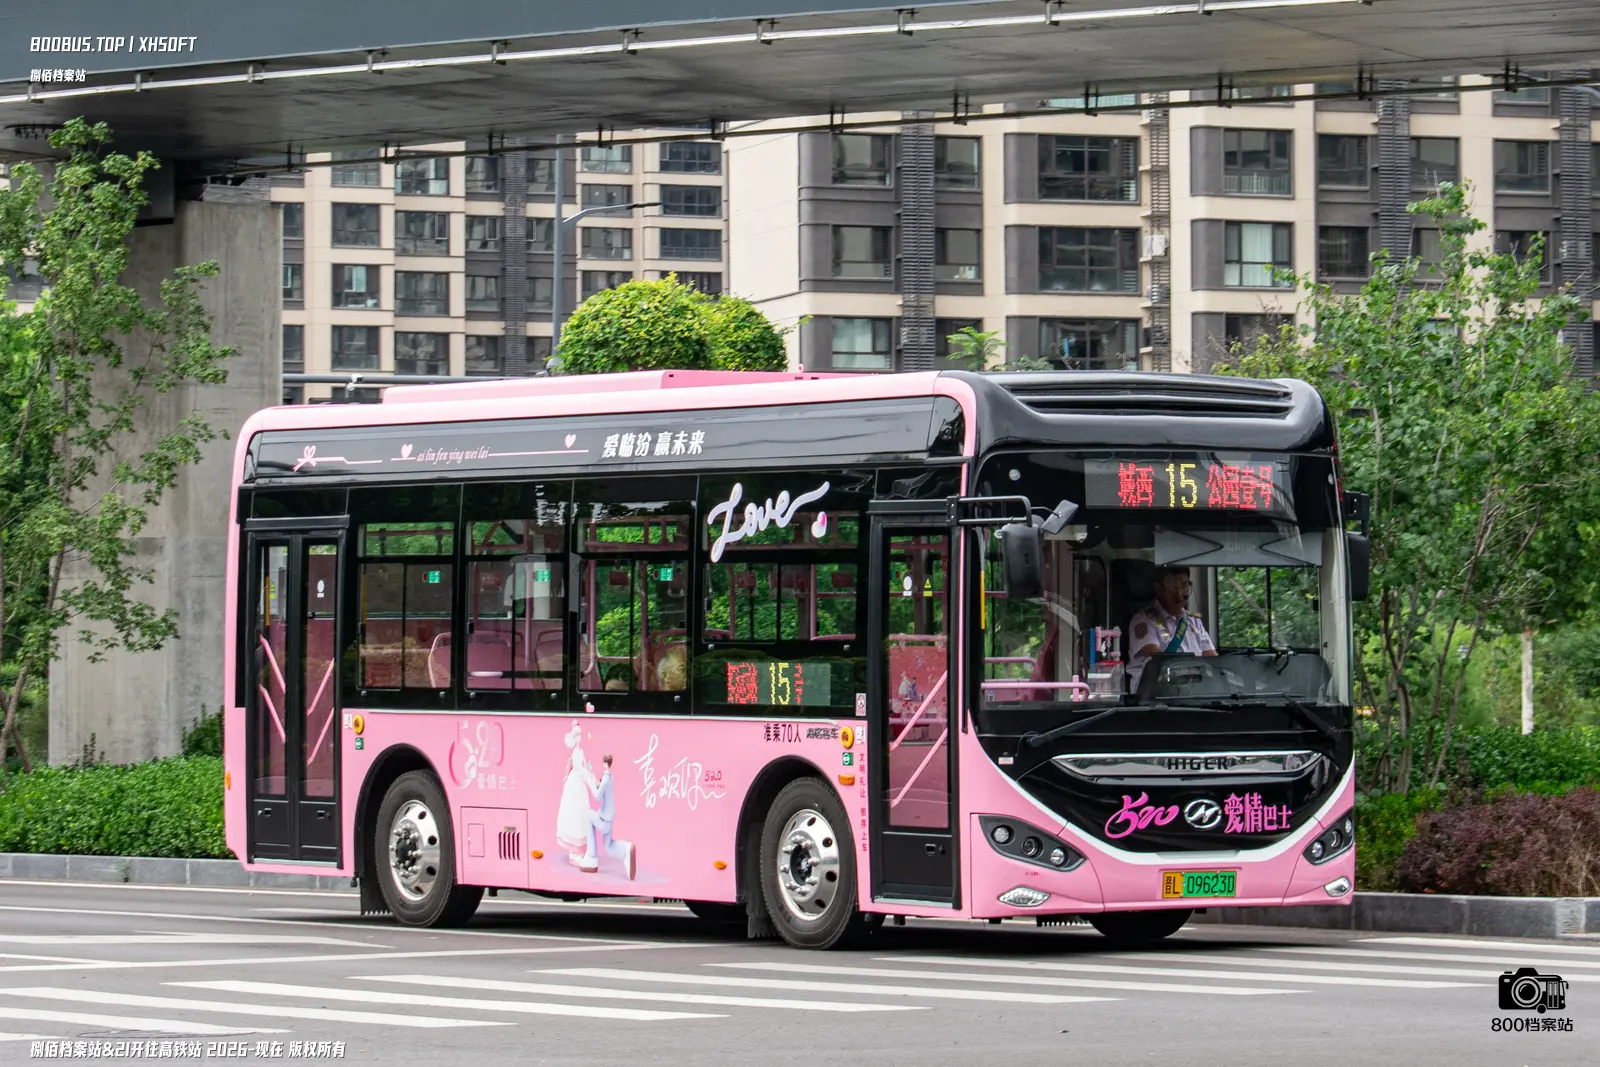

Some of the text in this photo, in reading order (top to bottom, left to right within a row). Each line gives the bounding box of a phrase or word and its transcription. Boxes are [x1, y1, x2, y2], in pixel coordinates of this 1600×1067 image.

[602, 430, 705, 458] 爱临汾 赢未来
[1165, 463, 1198, 508] 15
[707, 480, 830, 563] Love
[769, 662, 791, 706] 15
[763, 718, 802, 743] 准乘70人
[1166, 757, 1229, 771] HIGER
